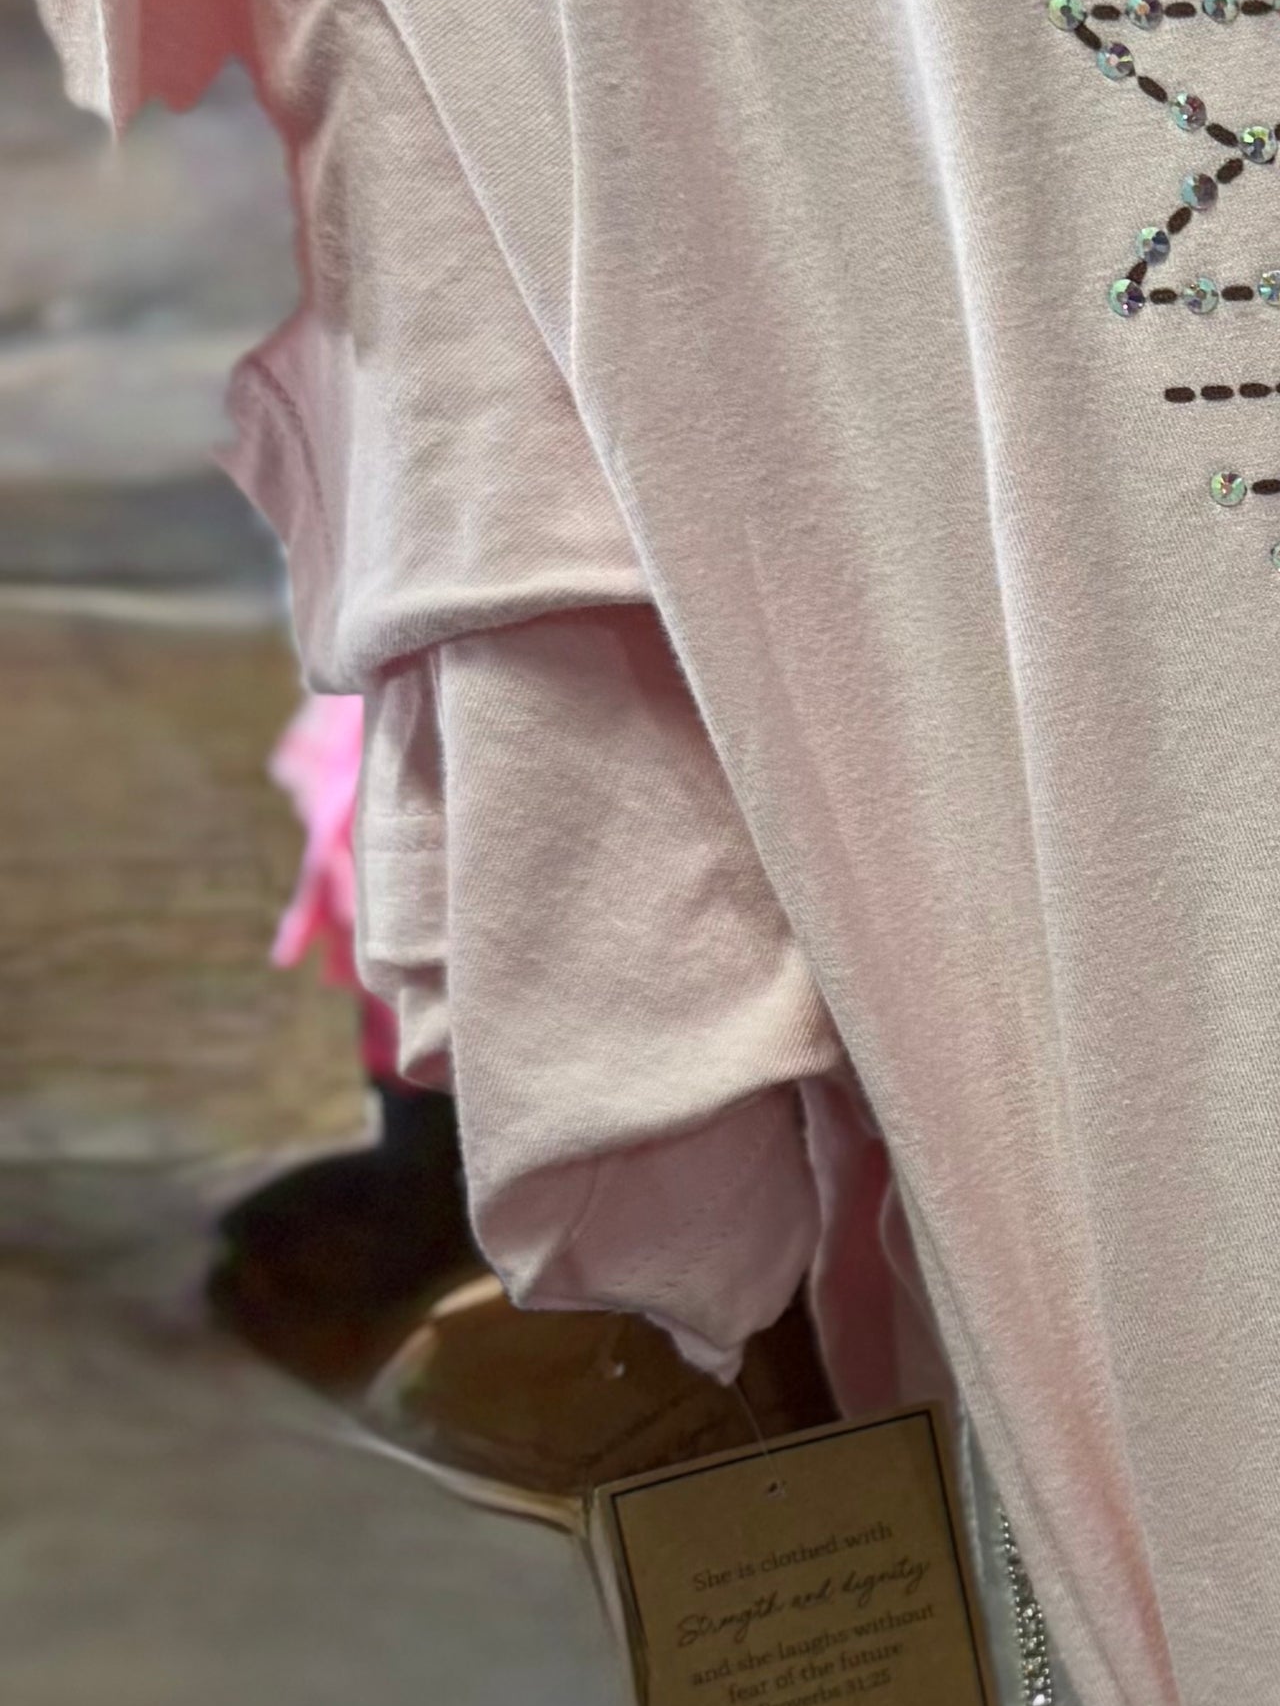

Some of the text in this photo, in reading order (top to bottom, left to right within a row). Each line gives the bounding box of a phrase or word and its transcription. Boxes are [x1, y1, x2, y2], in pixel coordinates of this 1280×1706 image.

[692, 1521, 894, 1593] She is clothed with
[677, 1555, 931, 1649] Strength and dignity
[691, 1603, 935, 1687] and she laughs without
[844, 1667, 892, 1694] 31:25
[727, 1680, 768, 1706] fear
[774, 1666, 798, 1691] of
[800, 1659, 836, 1684] the
